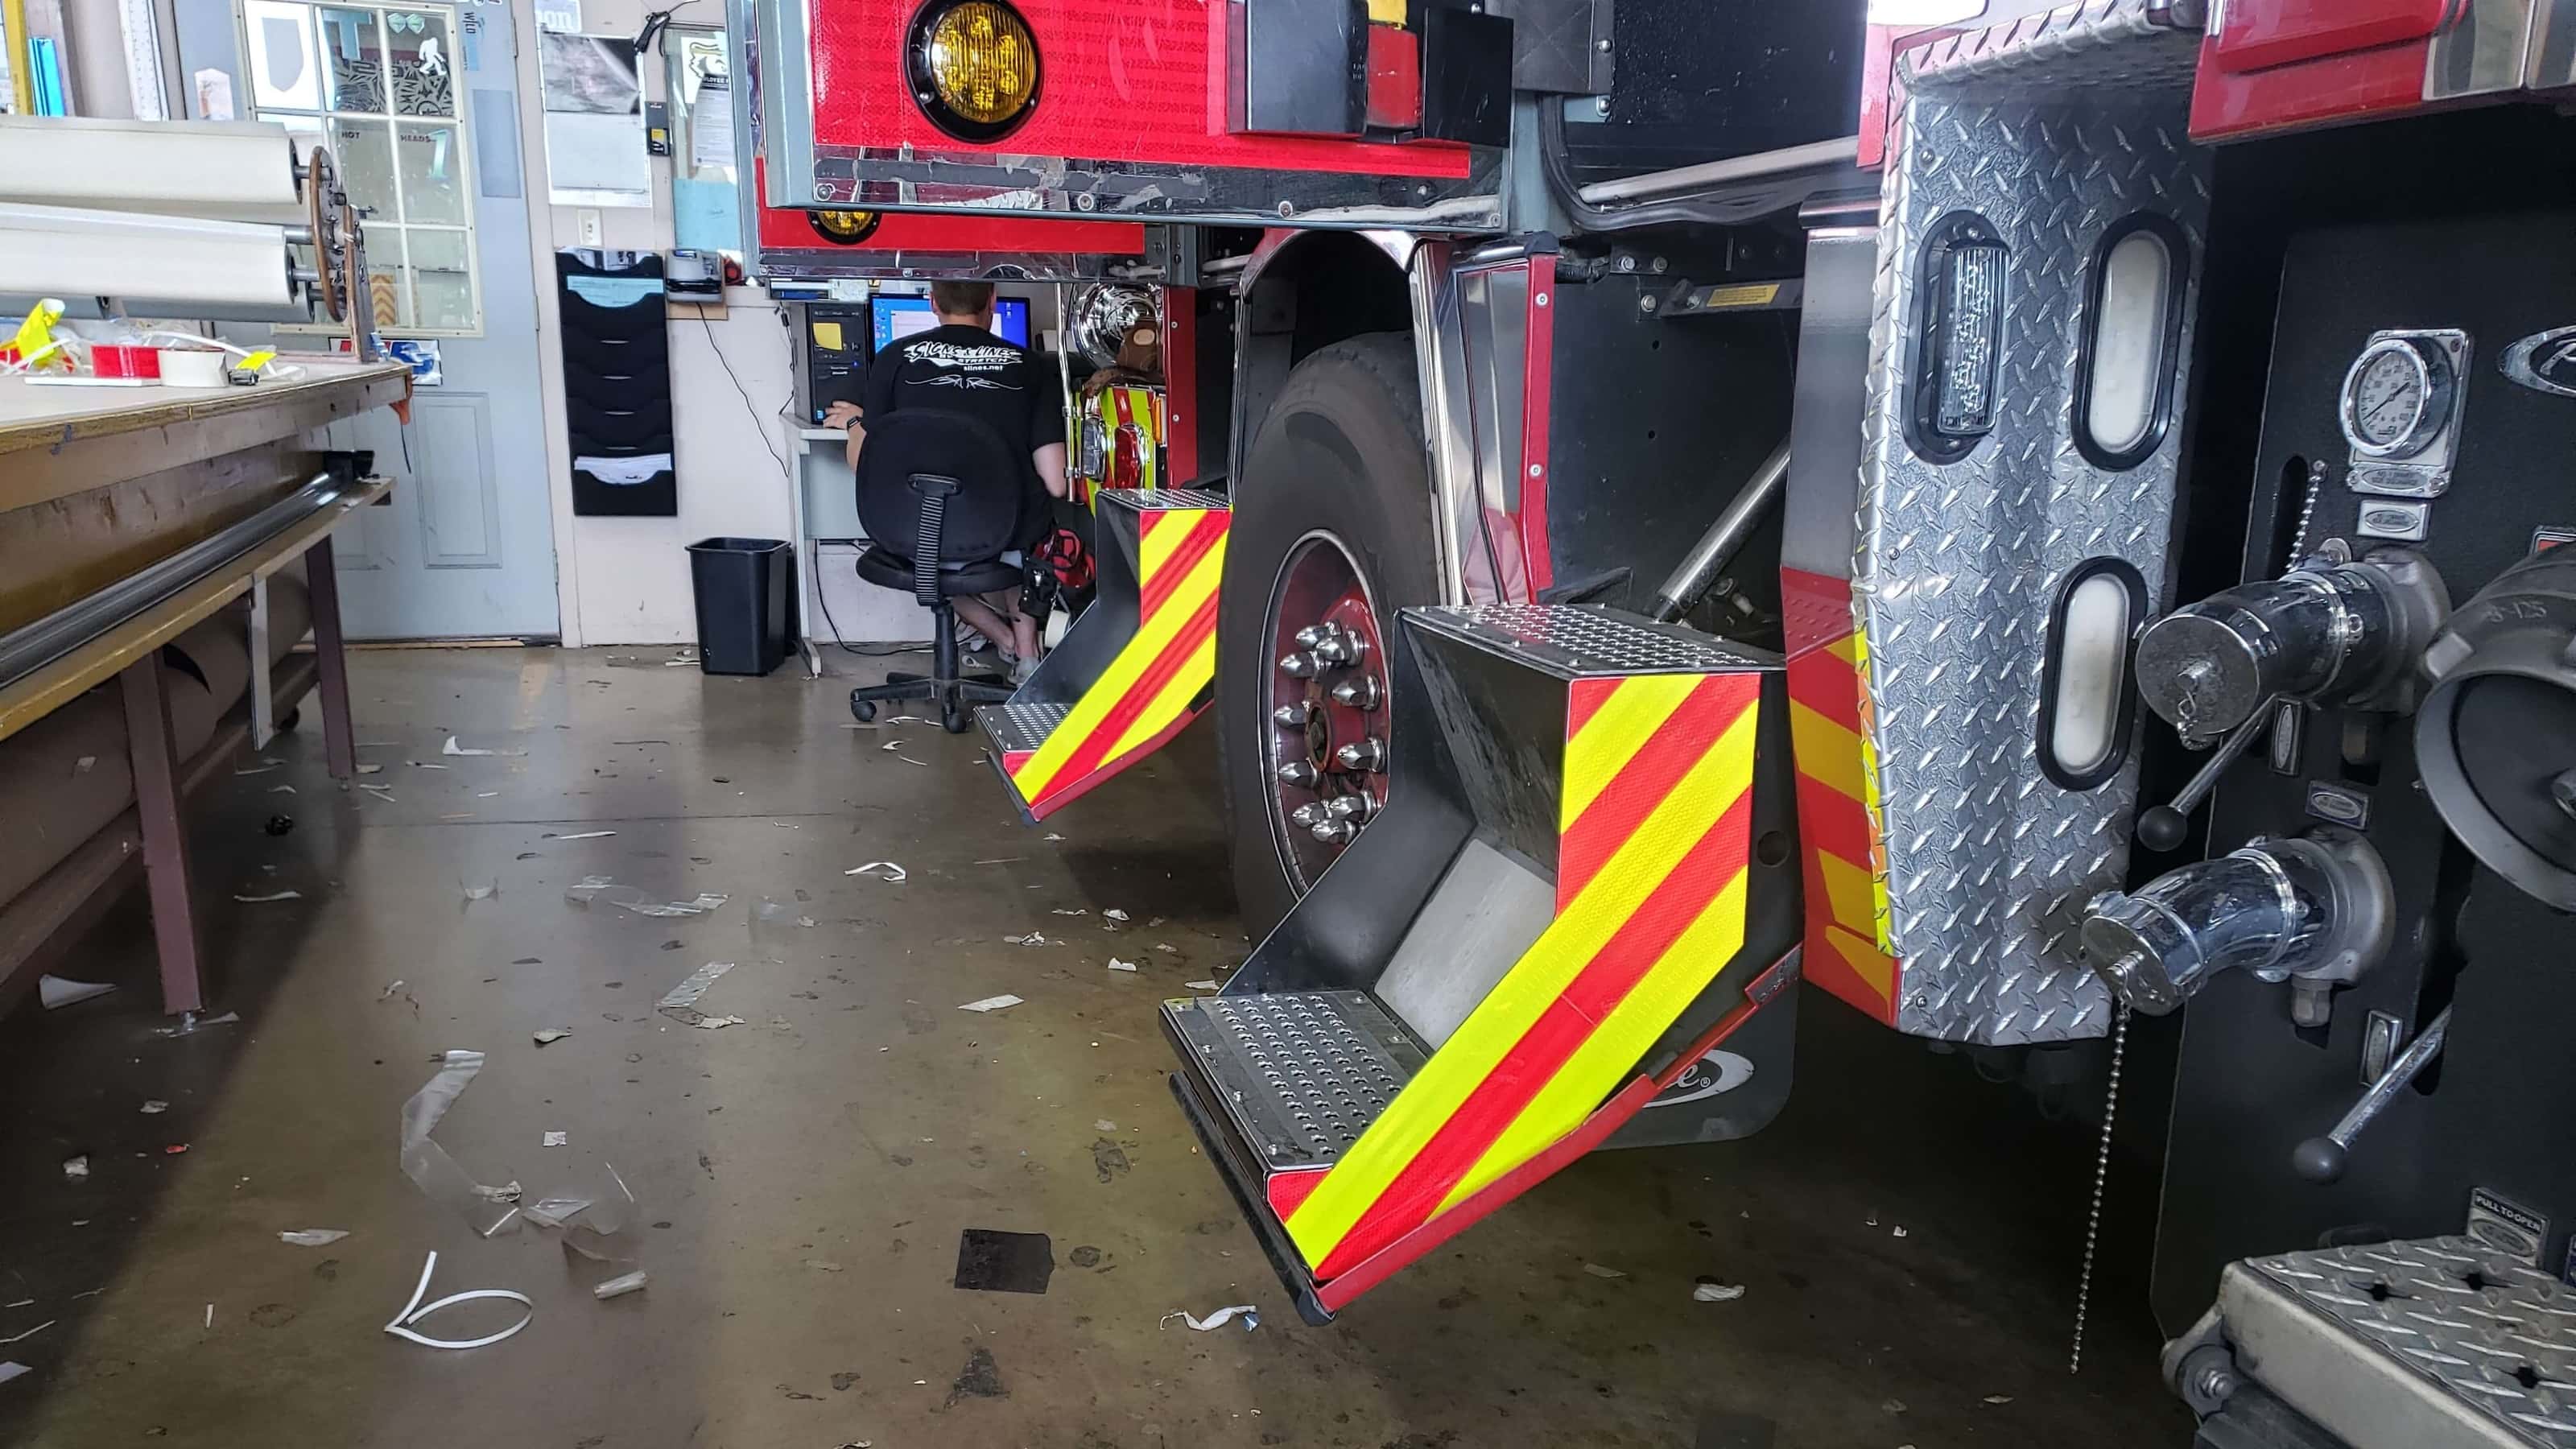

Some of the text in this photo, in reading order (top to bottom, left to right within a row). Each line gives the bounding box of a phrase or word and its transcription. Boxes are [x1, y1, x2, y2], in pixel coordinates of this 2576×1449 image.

[910, 341, 961, 362] SIGNS
[2475, 1195, 2500, 1212] PULL
[2500, 1206, 2513, 1218] TO
